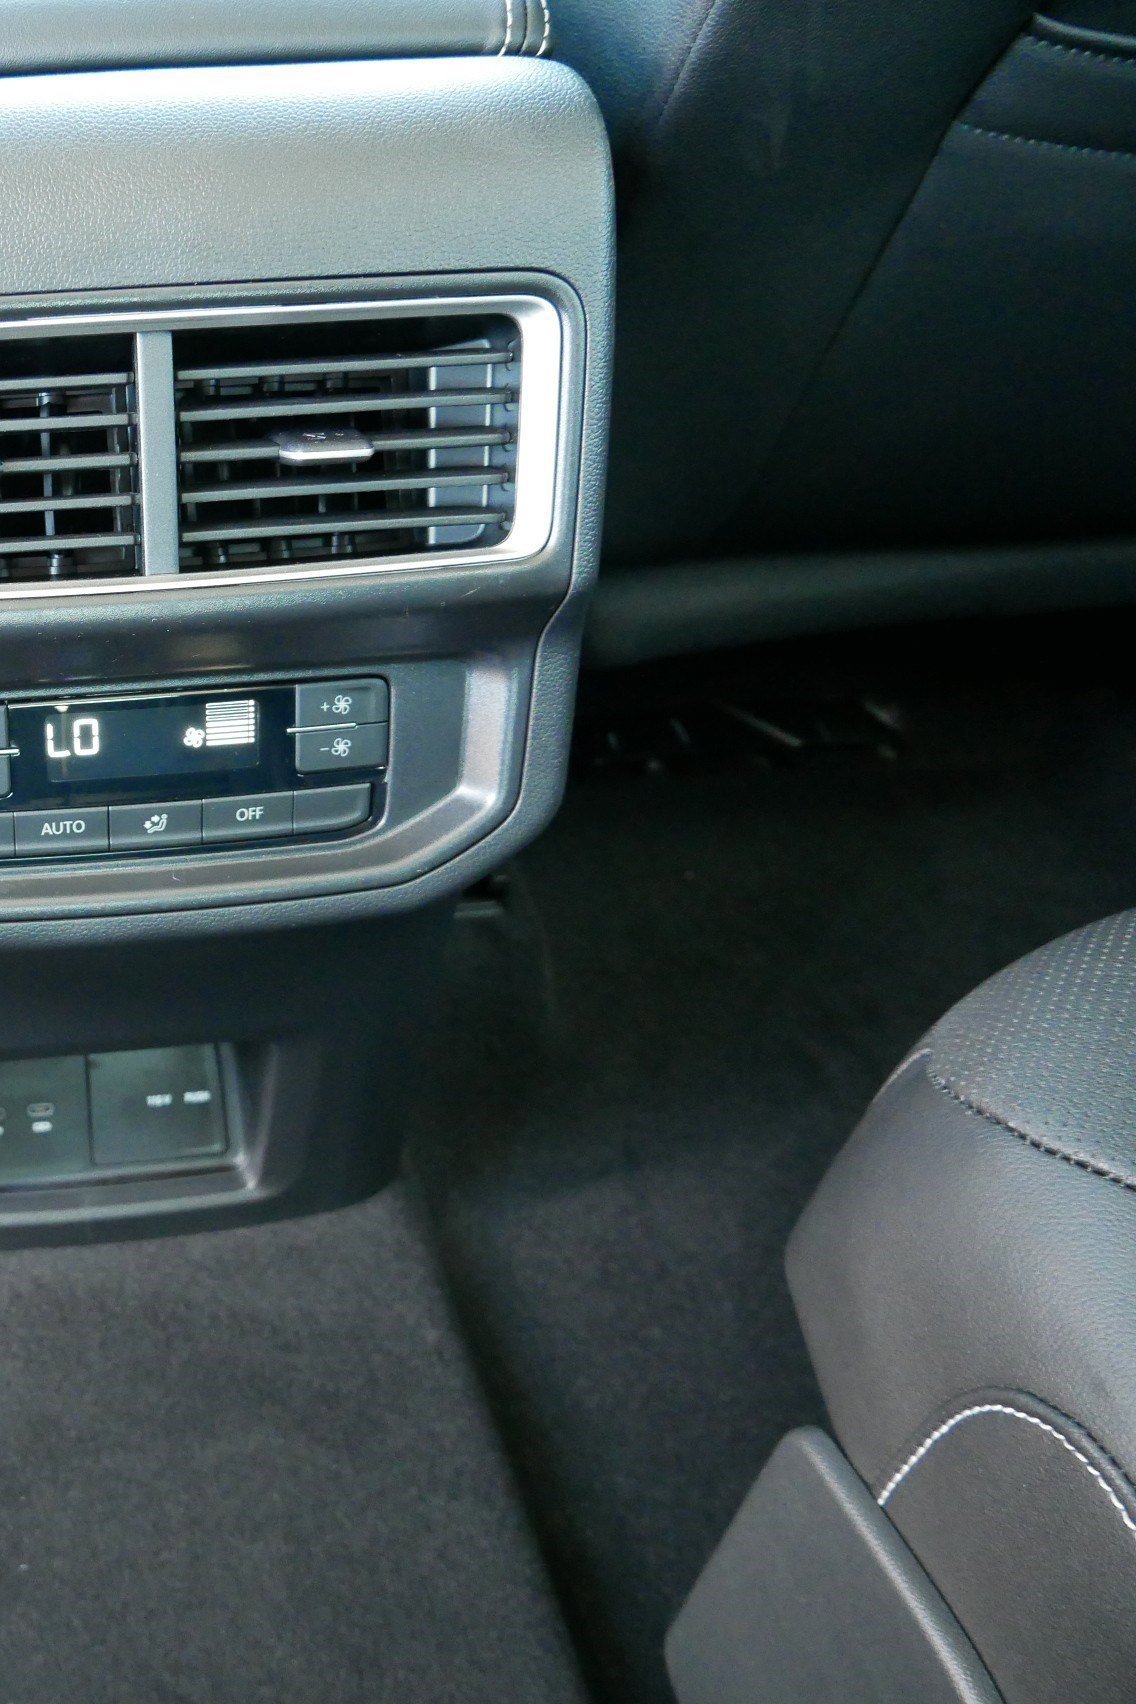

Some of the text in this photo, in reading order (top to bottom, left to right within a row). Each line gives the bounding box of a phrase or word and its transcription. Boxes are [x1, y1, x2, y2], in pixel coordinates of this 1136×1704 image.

[46, 718, 100, 758] LO
[235, 806, 264, 822] OFF
[41, 820, 86, 836] AUTO
